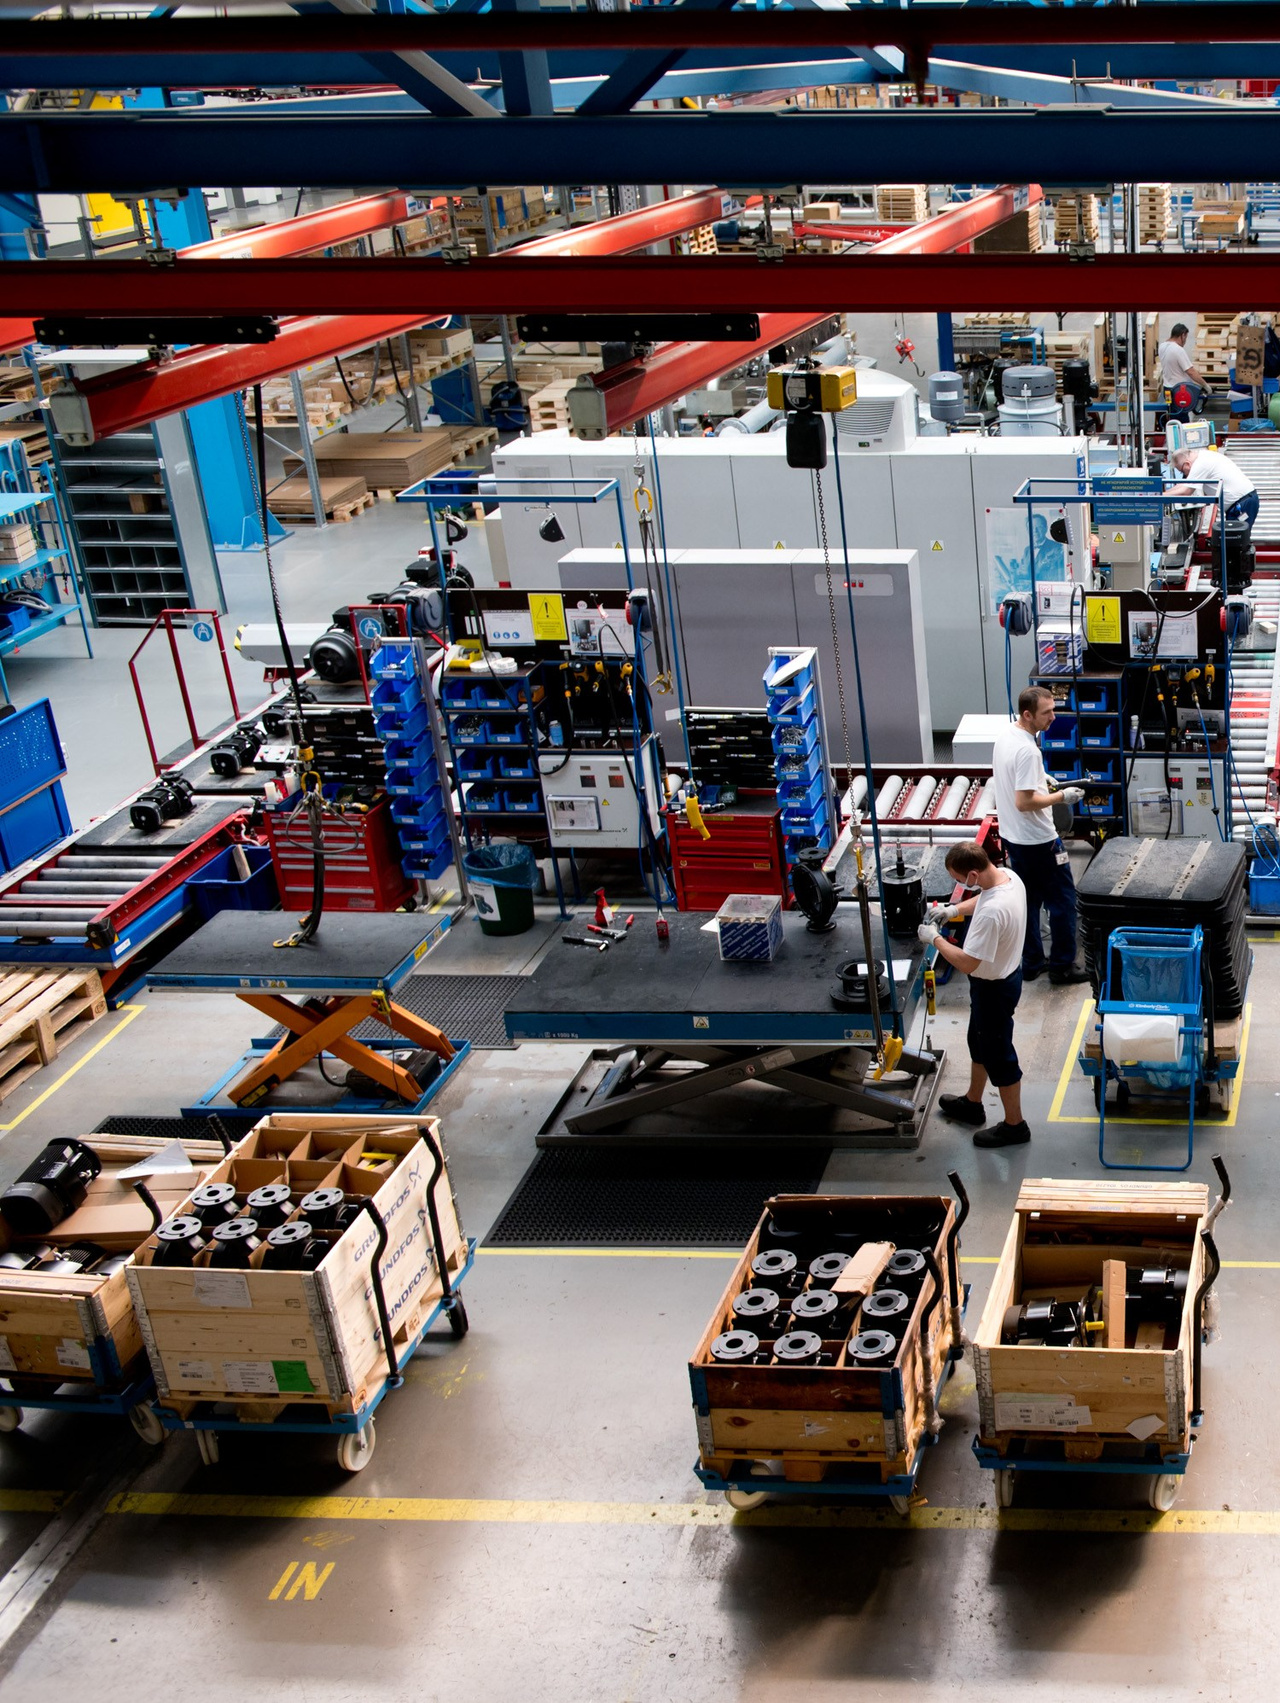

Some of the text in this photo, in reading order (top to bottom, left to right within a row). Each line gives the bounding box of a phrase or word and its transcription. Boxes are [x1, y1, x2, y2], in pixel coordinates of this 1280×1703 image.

[354, 1185, 411, 1262] GRUDFOS
[364, 1223, 421, 1301] GUNDFOS
[373, 1262, 428, 1342] GUNDFOS
[268, 1374, 275, 1383] 2
[267, 1561, 336, 1601] IN
